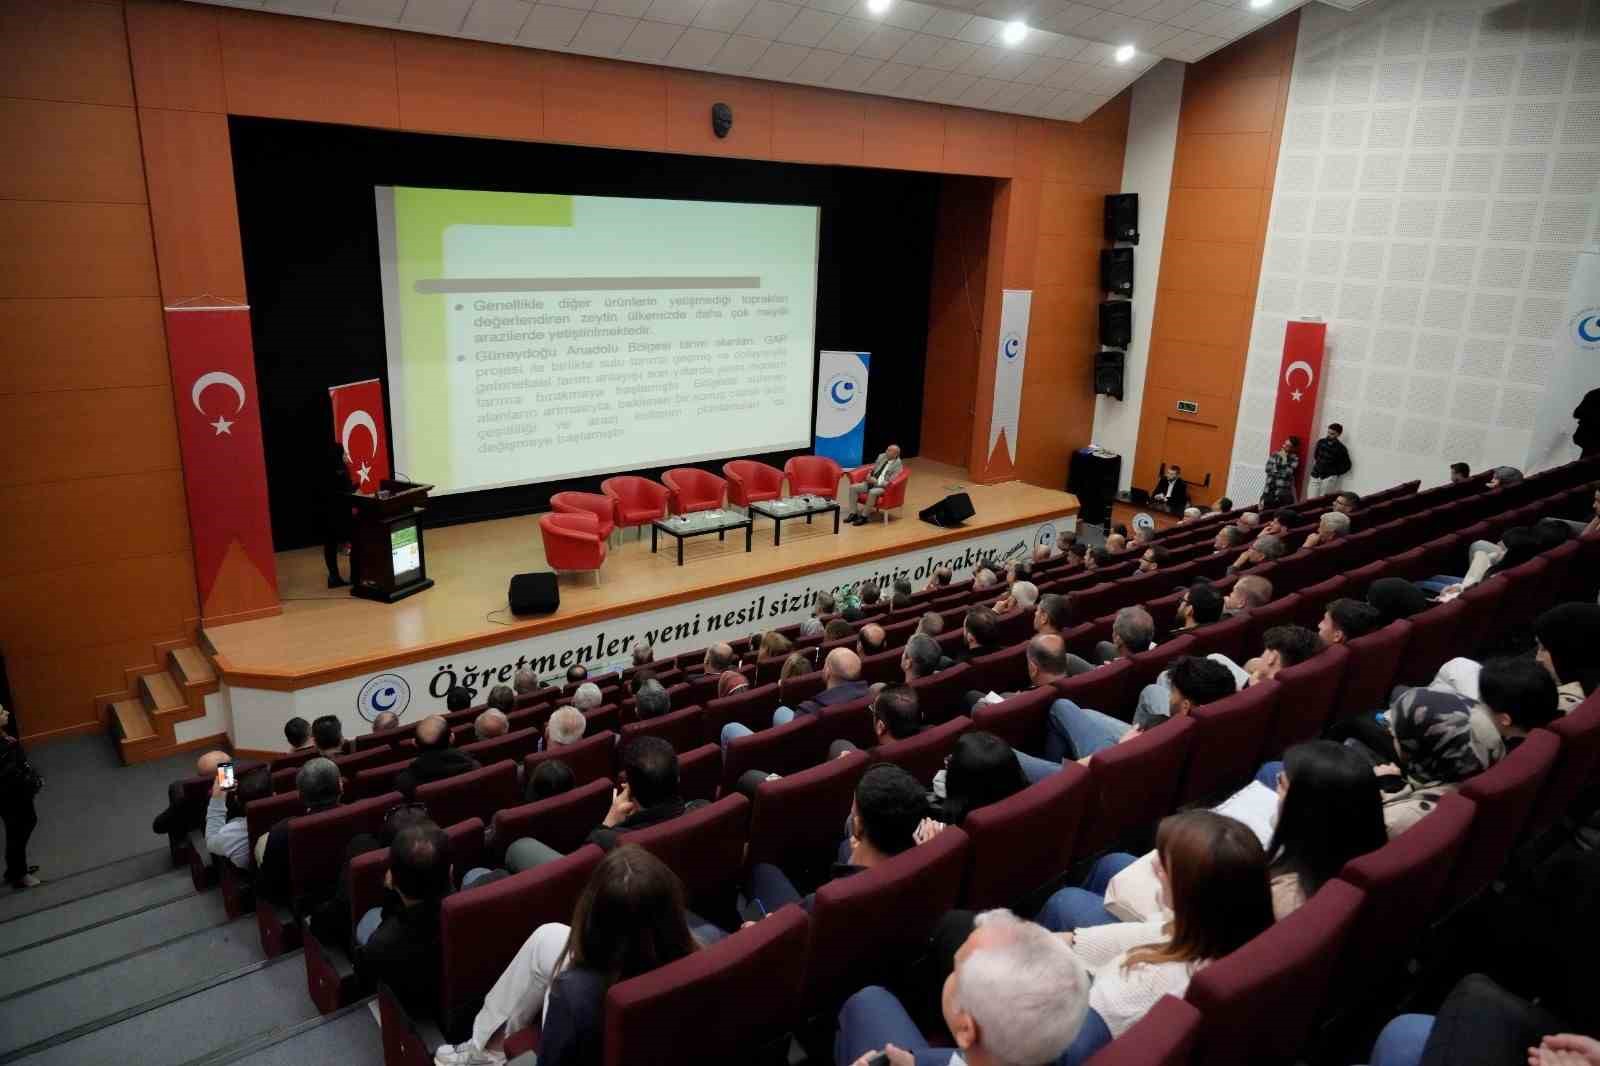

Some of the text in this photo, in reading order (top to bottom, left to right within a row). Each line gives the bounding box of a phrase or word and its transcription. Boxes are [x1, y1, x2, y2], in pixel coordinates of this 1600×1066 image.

[567, 344, 618, 355] Anadolu
[644, 613, 700, 646] yeni
[707, 596, 766, 632] nesil
